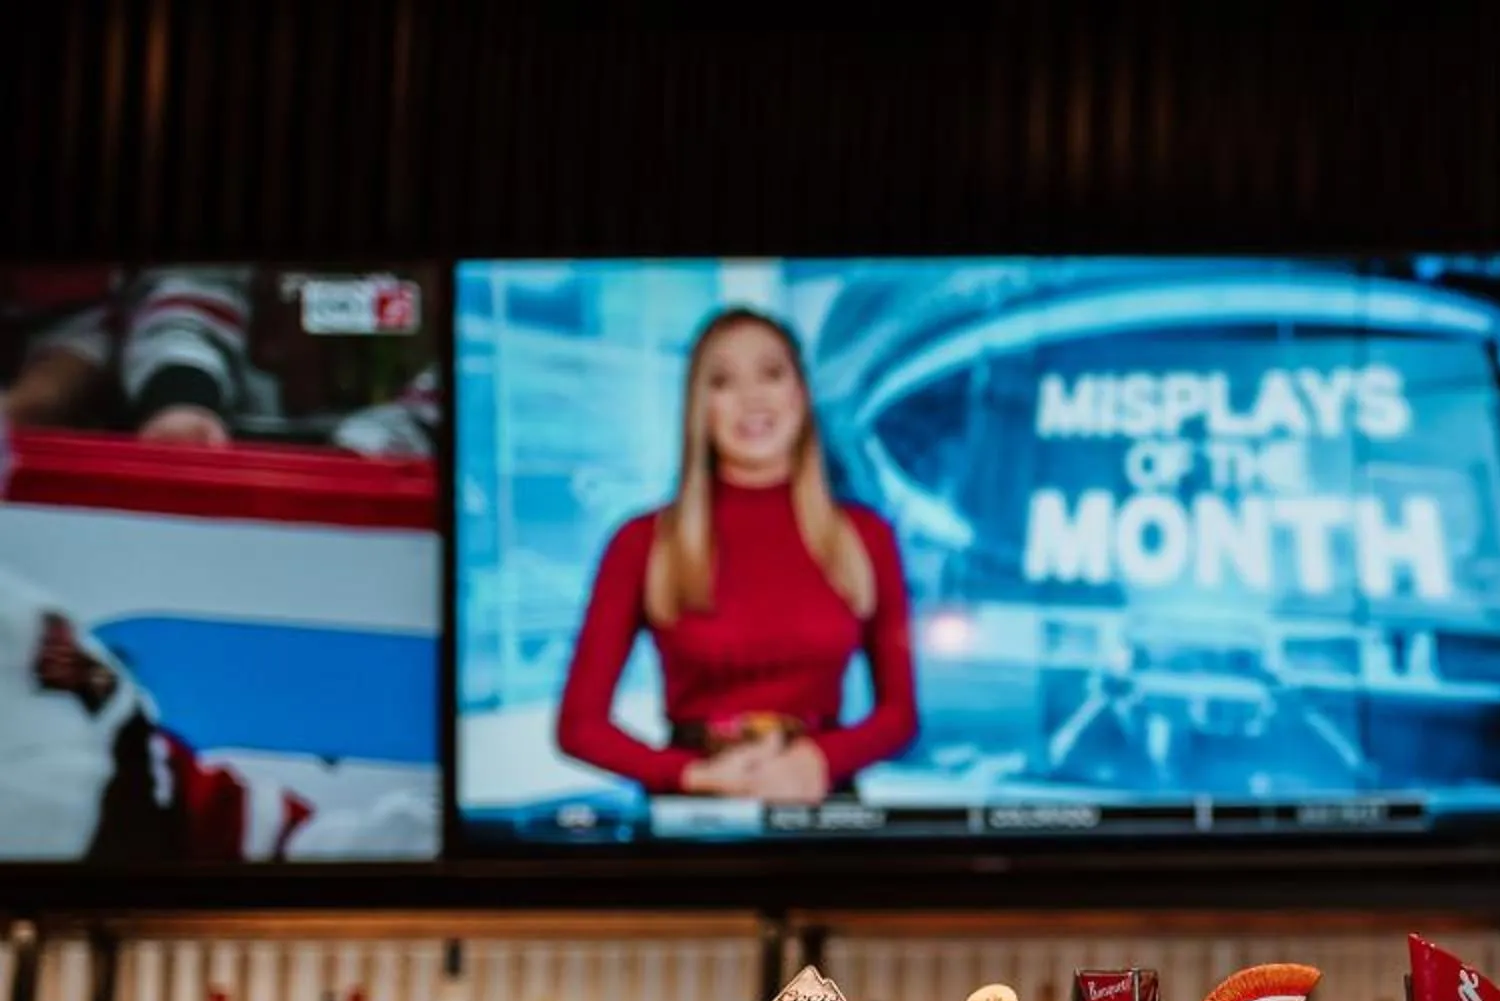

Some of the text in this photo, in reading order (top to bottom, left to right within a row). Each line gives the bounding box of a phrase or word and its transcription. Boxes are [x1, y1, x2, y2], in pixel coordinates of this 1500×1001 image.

[1036, 366, 1411, 440] MISPLAYS
[1125, 438, 1195, 490] OF
[1024, 488, 1453, 600] MONTH
